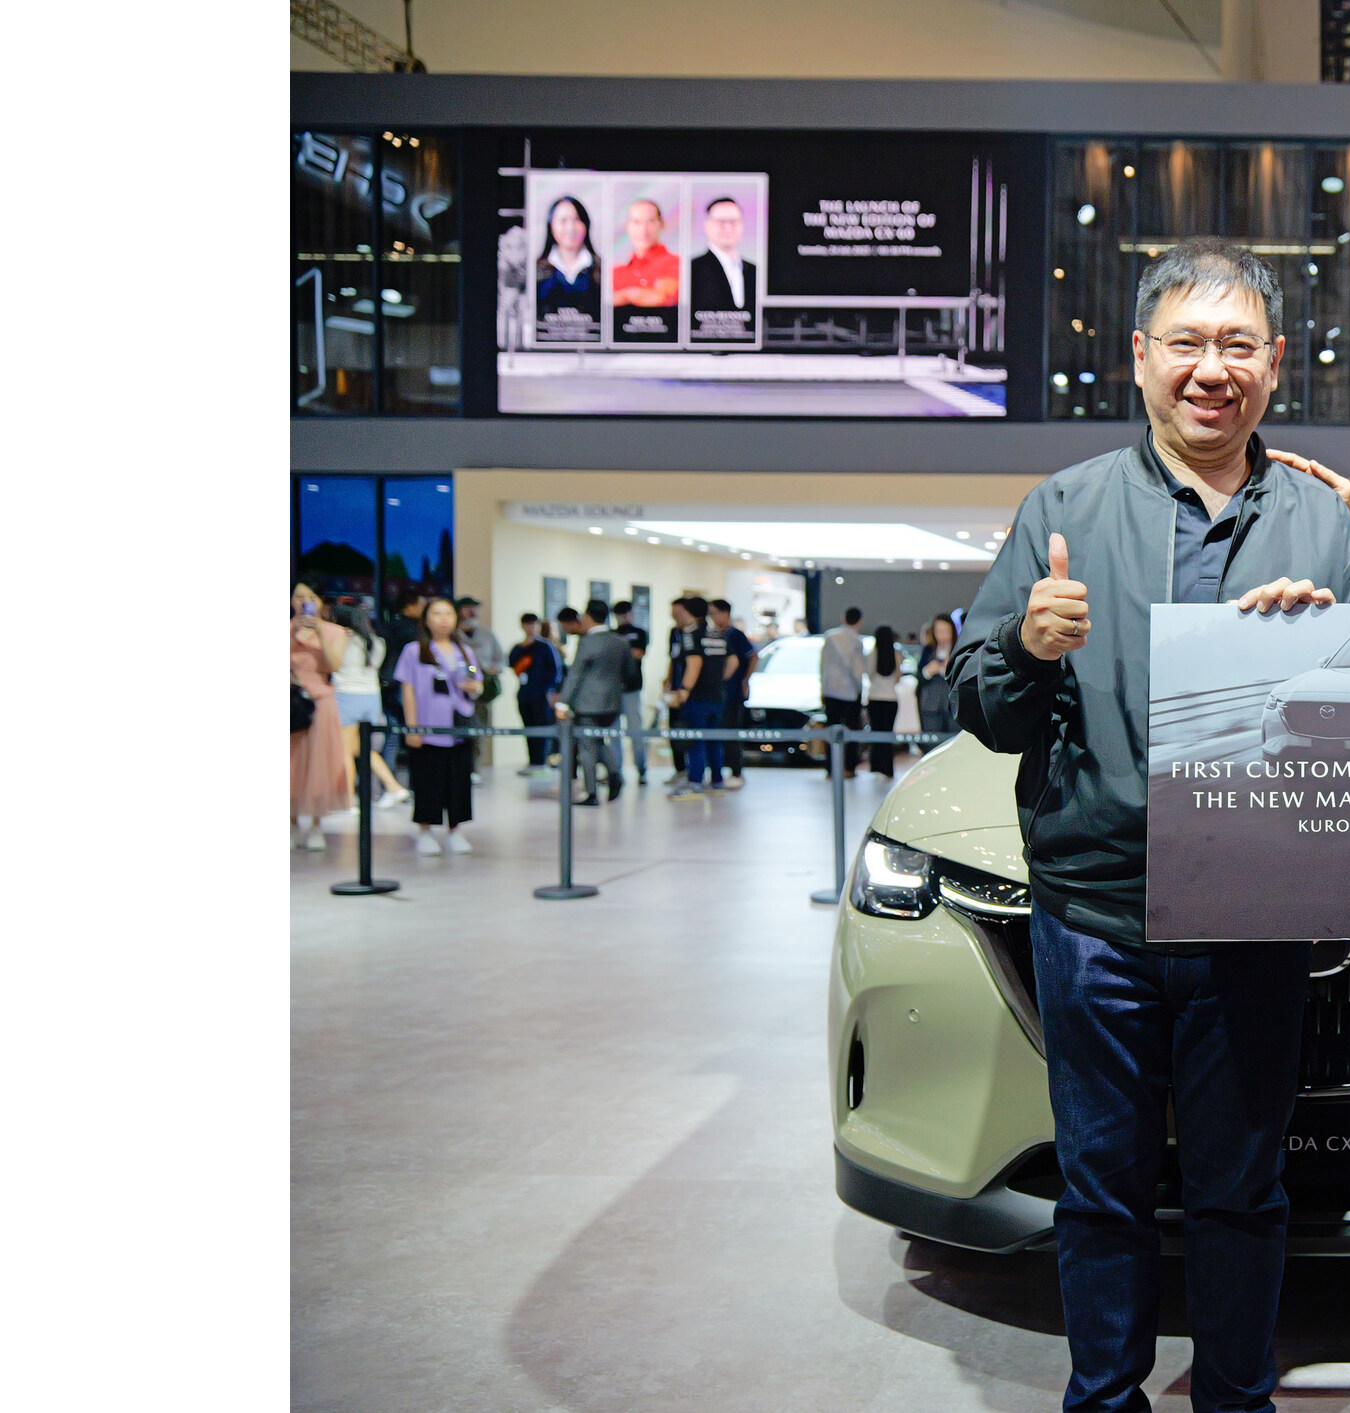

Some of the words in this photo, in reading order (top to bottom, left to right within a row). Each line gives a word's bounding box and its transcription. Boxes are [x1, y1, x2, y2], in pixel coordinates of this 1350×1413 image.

[1171, 761, 1235, 779] FIRST
[1192, 791, 1238, 809] THE
[1250, 791, 1305, 809] NEW
[1298, 819, 1350, 833] KURO
